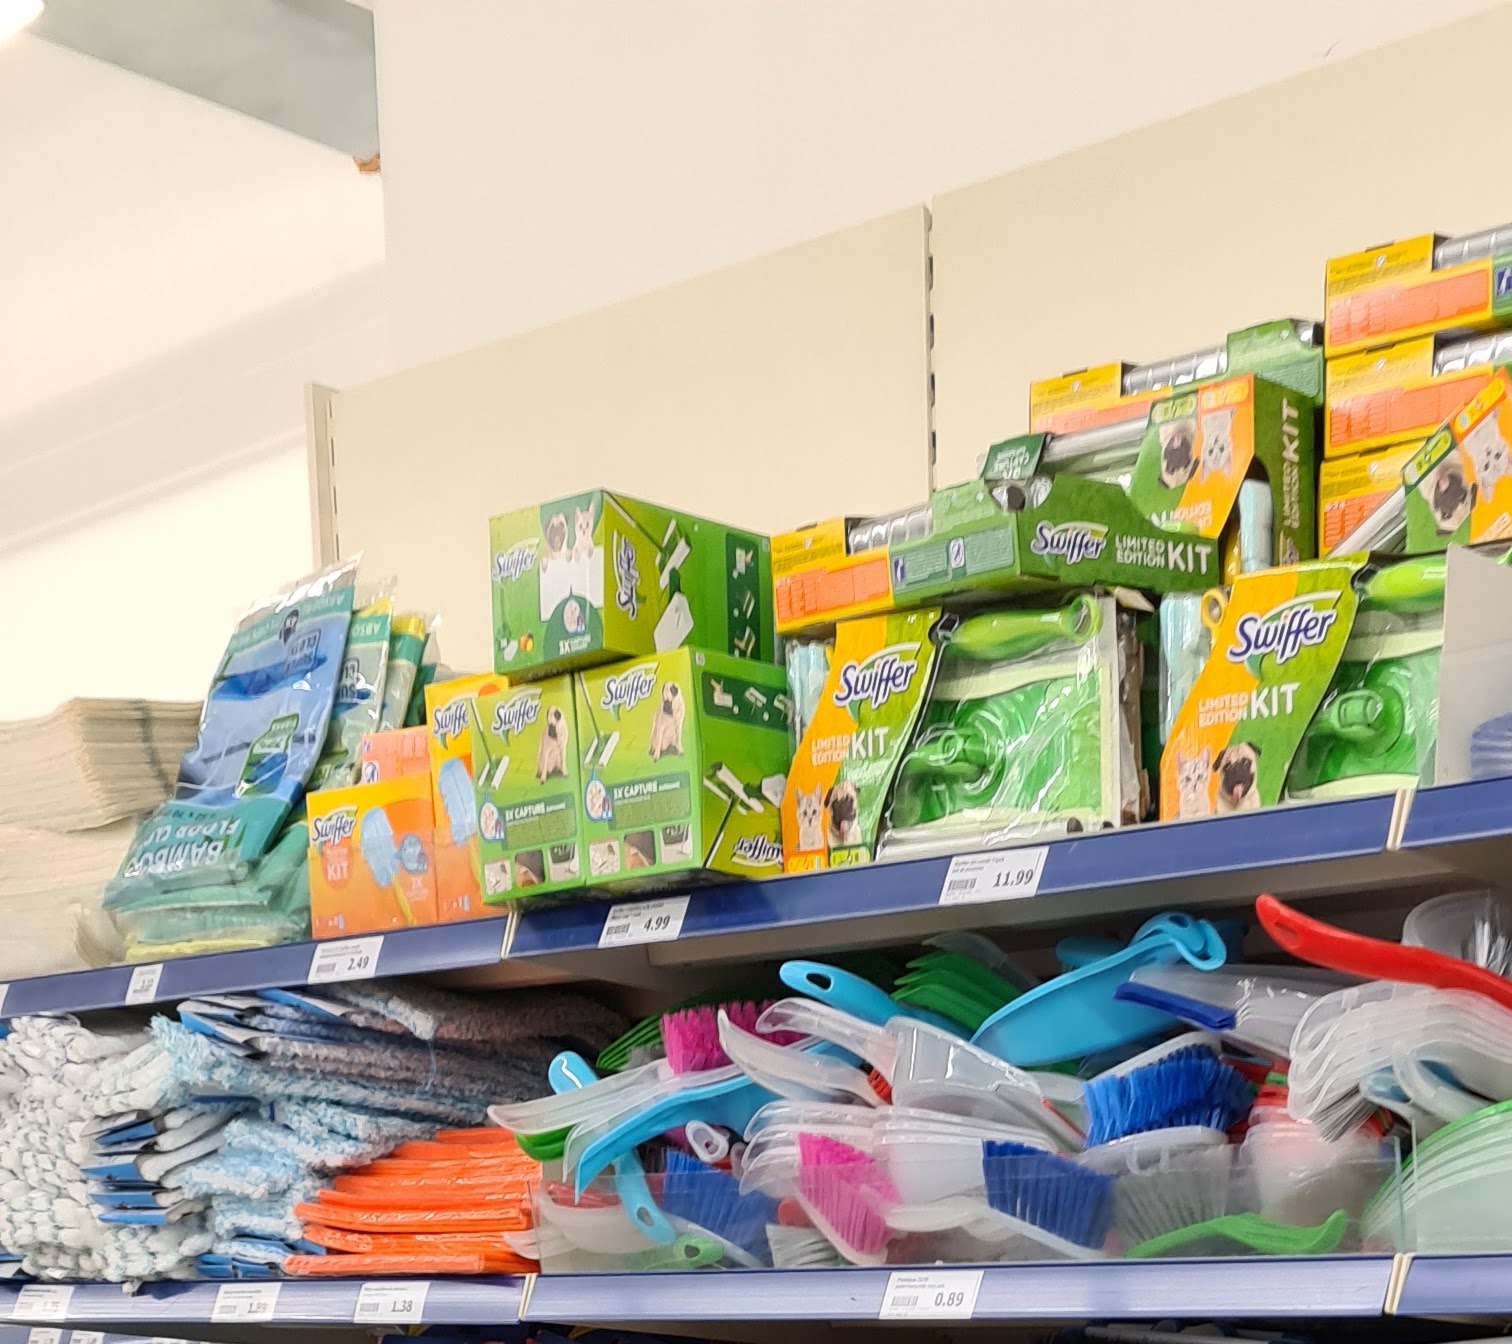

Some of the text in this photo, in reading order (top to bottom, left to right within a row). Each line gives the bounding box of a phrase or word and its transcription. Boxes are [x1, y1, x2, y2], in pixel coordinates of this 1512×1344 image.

[1031, 521, 1107, 565] Swiffer
[1115, 533, 1166, 552] LIMITED
[1116, 547, 1167, 569] EDITION
[1167, 540, 1212, 575] KIT
[493, 548, 537, 582] Swiffer
[1227, 606, 1336, 665] Swiffer
[603, 669, 656, 711] Swiffer
[834, 655, 917, 709] Swiffer
[492, 697, 540, 735] Swiffer
[1198, 691, 1248, 713] LIMITED
[1199, 708, 1248, 728] EDITION
[1250, 683, 1300, 720] KIT
[432, 701, 469, 738] Swiffe
[811, 733, 850, 753] LIMITED
[811, 749, 850, 768] EDITION
[851, 726, 889, 760] KIT
[312, 811, 356, 846] Swiffer
[991, 868, 1035, 889] 11.99
[643, 915, 672, 933] 4.99
[346, 955, 371, 972] 2.49
[934, 1291, 965, 1307] 0.89
